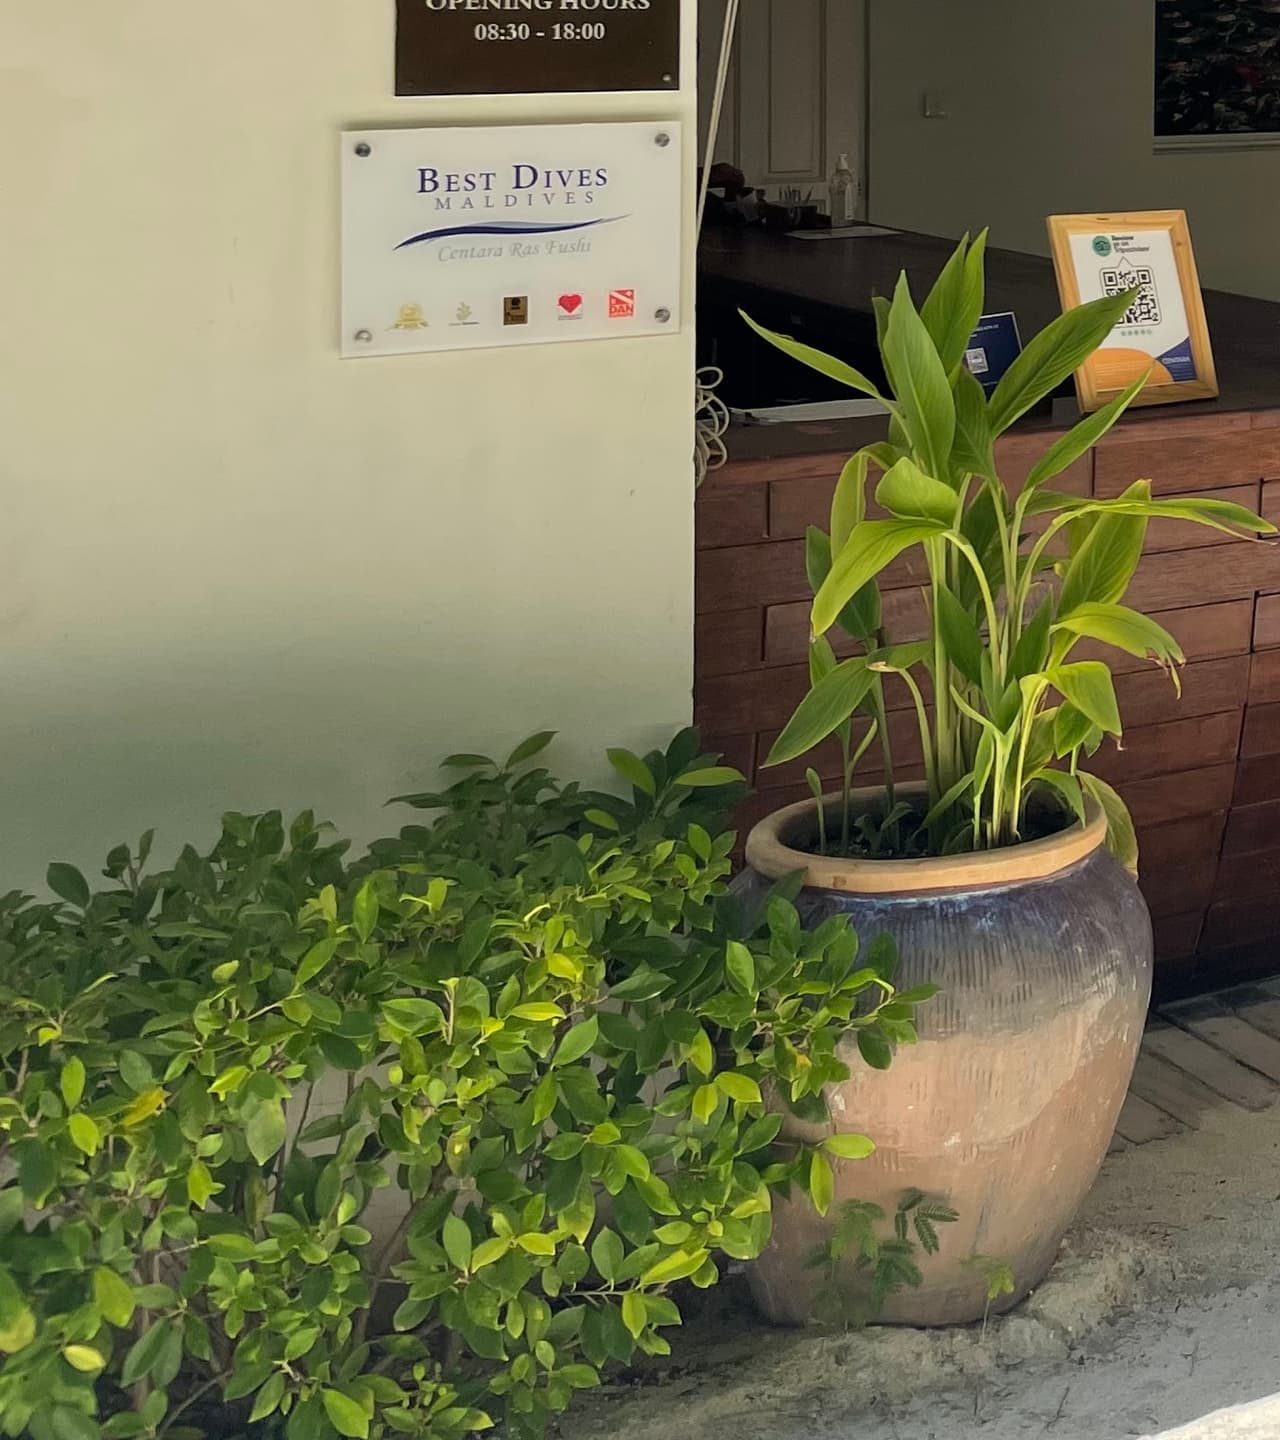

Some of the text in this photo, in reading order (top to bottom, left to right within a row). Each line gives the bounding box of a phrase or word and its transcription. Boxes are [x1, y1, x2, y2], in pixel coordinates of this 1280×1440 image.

[474, 23, 531, 40] 08:30
[551, 22, 606, 40] 18:00
[434, 191, 594, 210] MALDIVES
[437, 237, 592, 262] Centara Ras Fushi
[609, 305, 634, 314] DAN
